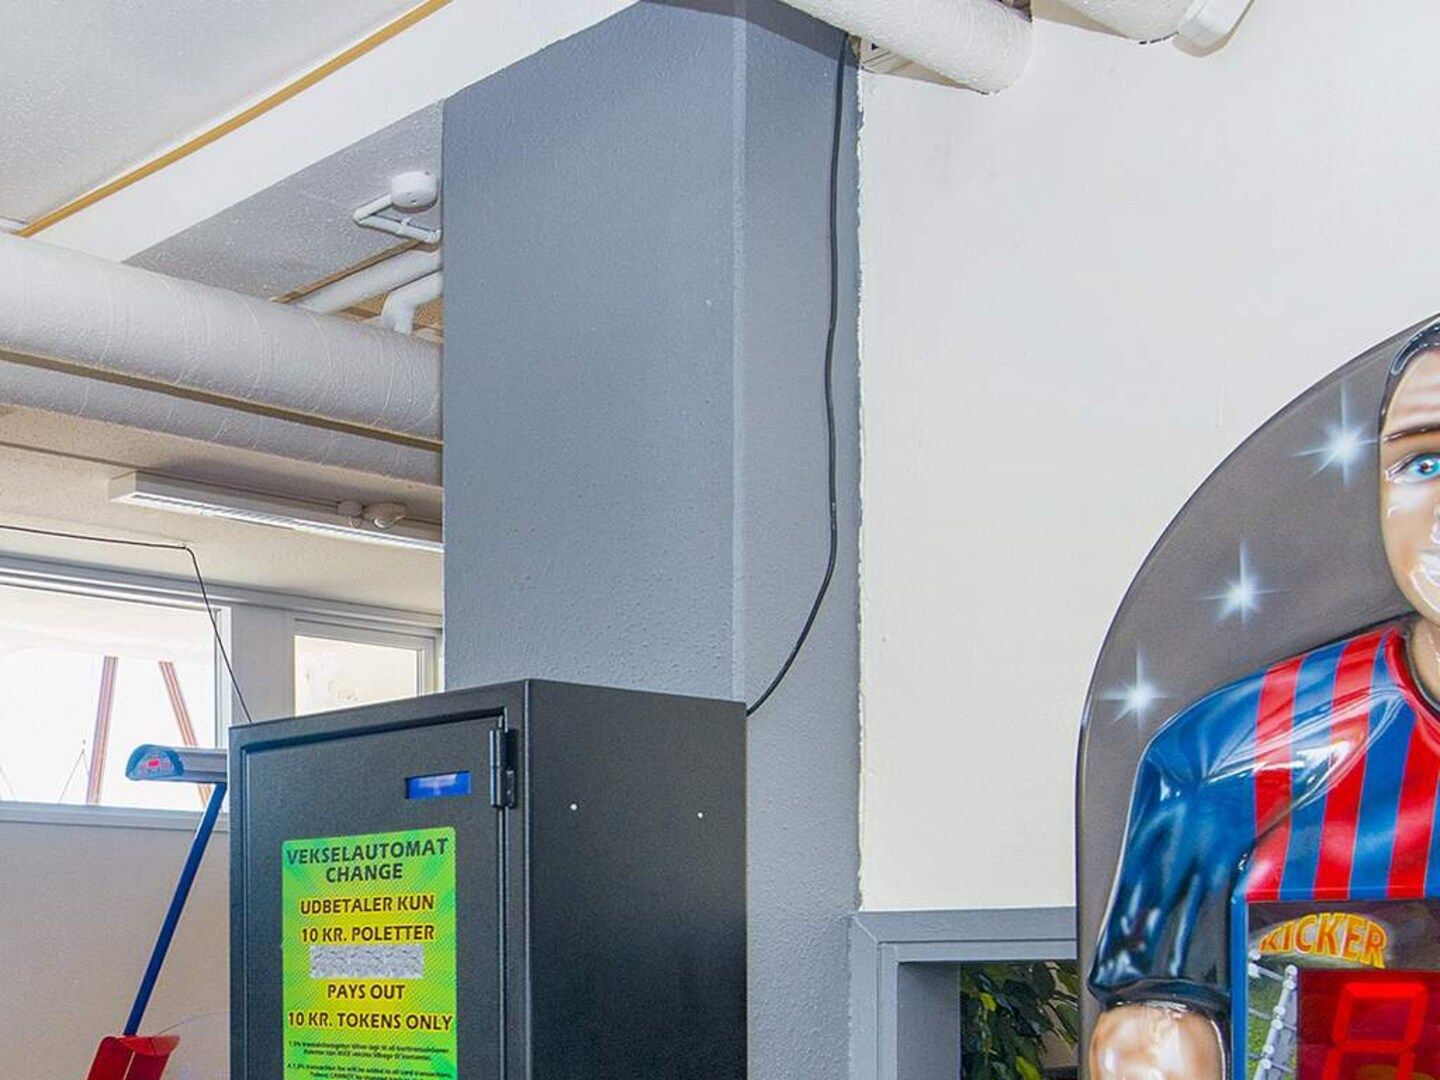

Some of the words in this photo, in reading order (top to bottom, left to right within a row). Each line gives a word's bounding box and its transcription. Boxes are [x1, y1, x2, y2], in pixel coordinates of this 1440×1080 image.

[287, 837, 449, 865] VEKSELAUTOMAT
[325, 862, 403, 883] CHANGE
[300, 896, 393, 915] UDBETALER
[397, 895, 435, 911] KUN
[302, 928, 319, 943] 10
[322, 927, 348, 942] KR.
[352, 924, 435, 942] POLETTER
[1258, 911, 1388, 969] KICKER
[327, 984, 366, 999] PAYS
[370, 984, 406, 1000] OUT
[288, 1012, 305, 1027] 10
[308, 1012, 333, 1027] KR.
[337, 1013, 401, 1029] TOKENS
[405, 1014, 453, 1031] ONLY
